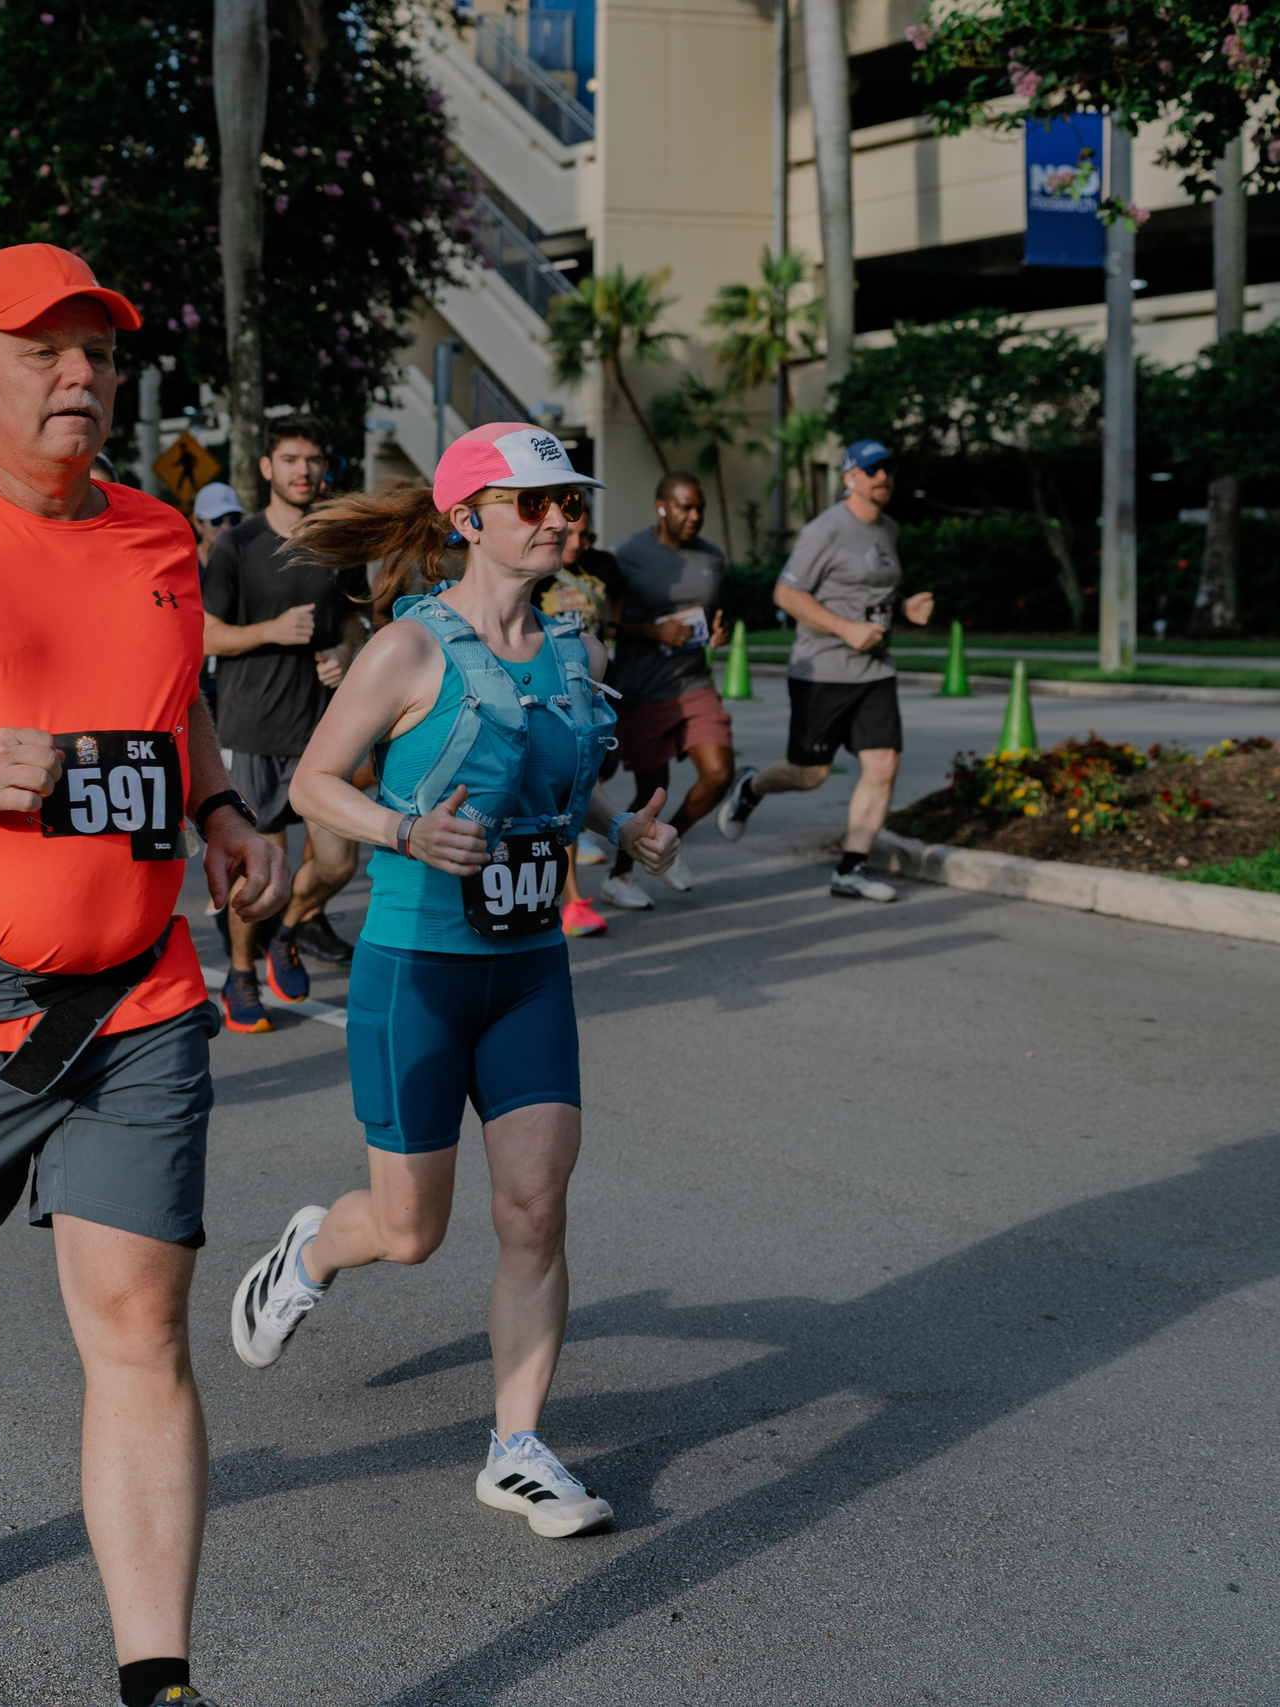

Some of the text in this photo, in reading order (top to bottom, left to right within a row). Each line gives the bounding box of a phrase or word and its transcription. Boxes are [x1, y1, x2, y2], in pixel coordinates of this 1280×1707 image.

[531, 437, 556, 451] Party
[539, 447, 561, 461] Pace
[127, 740, 157, 760] 5K
[67, 765, 167, 834] 597
[458, 801, 497, 829] AMELBAK
[154, 842, 171, 850] TACO
[531, 841, 552, 857] 5K
[482, 860, 558, 916] 944
